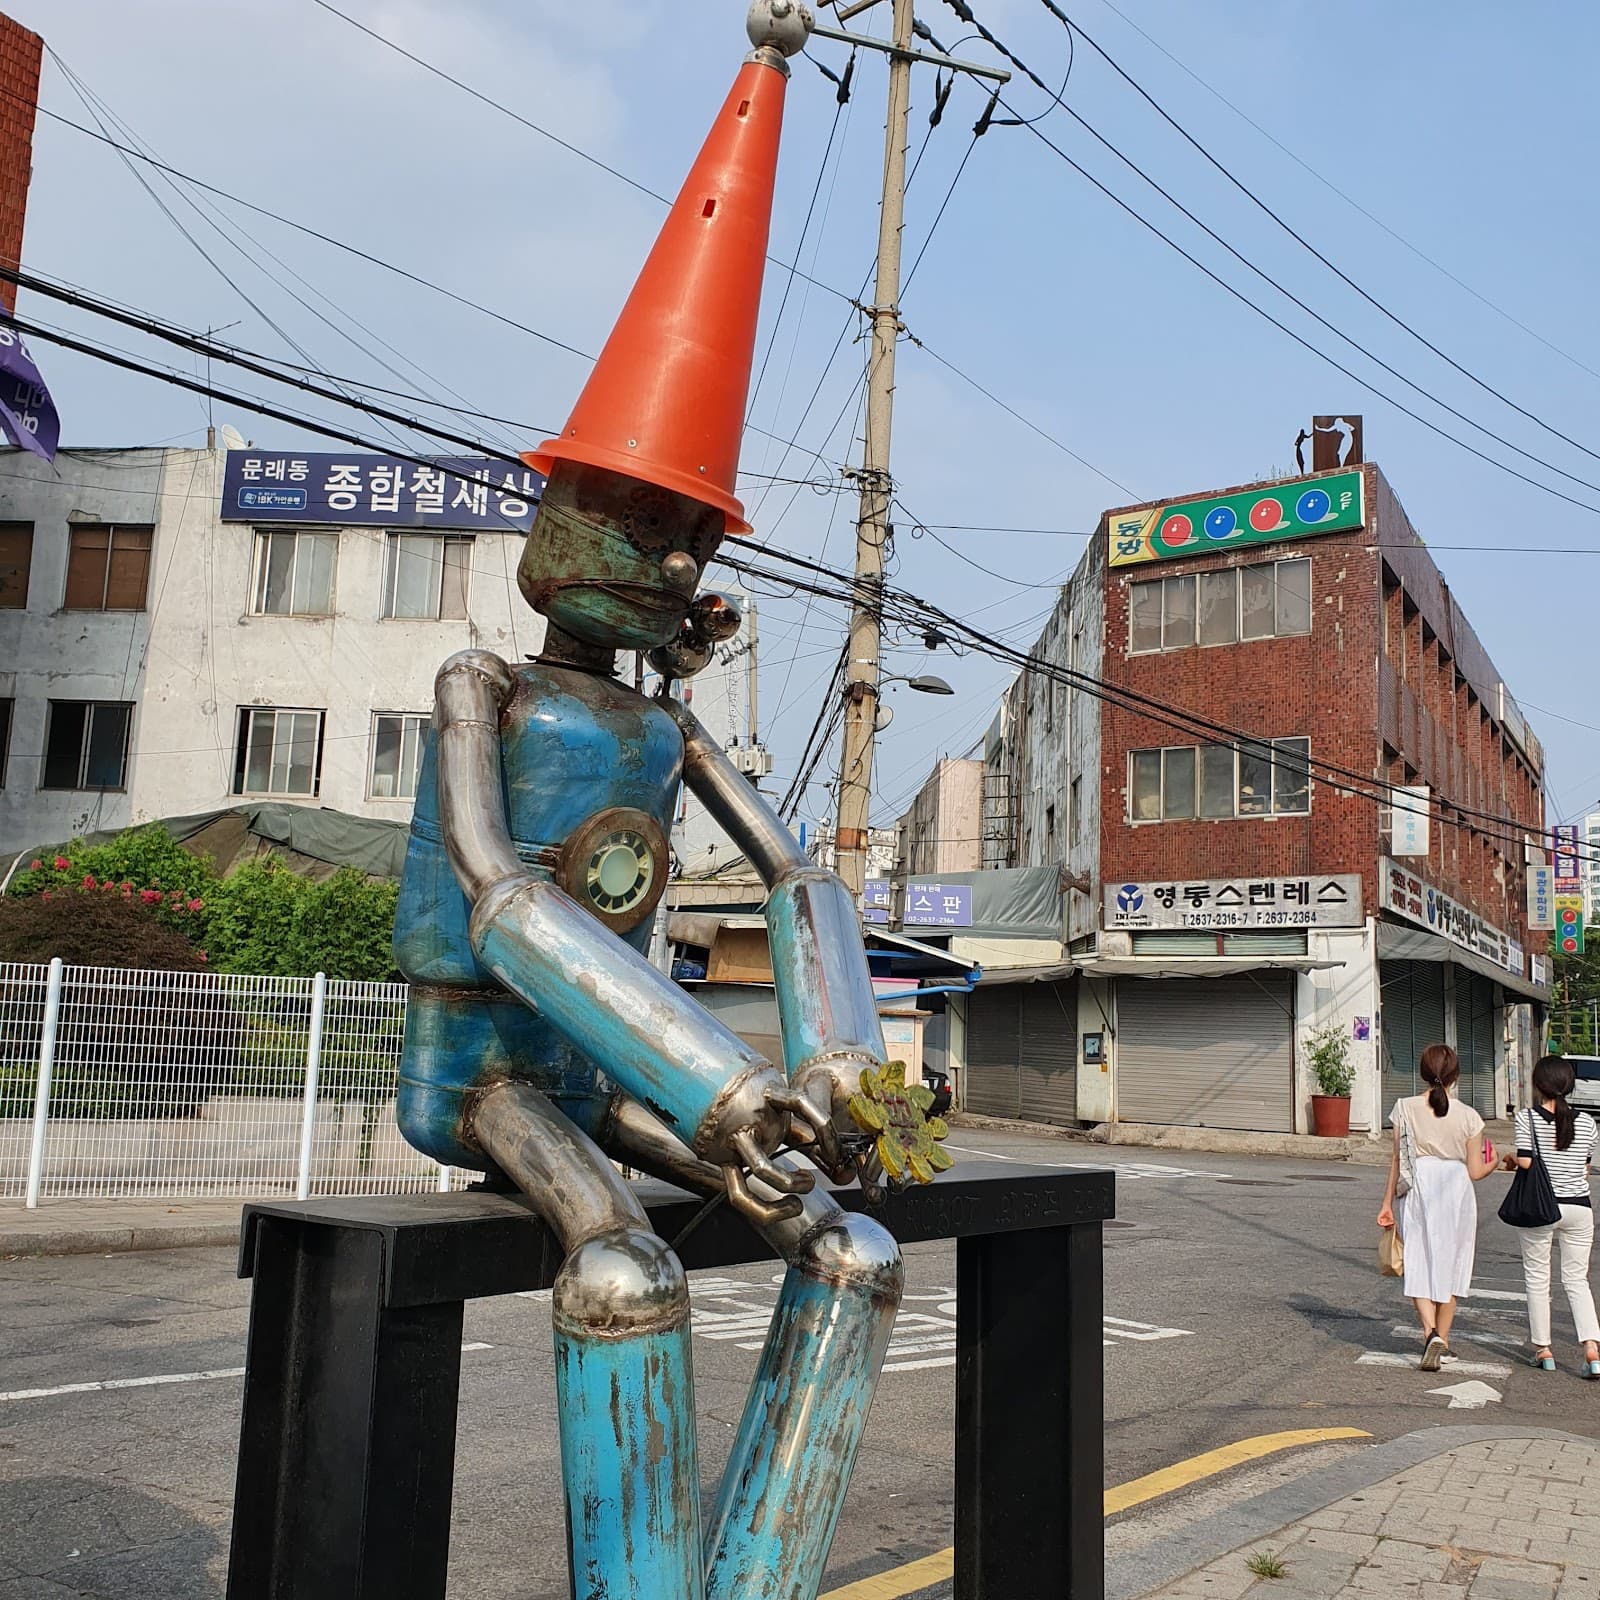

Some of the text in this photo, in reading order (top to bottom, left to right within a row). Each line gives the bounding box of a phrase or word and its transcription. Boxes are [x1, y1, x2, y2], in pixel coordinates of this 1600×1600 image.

[241, 459, 310, 481] 문래동
[324, 464, 547, 517] 종합철재상
[1340, 491, 1353, 510] 2F
[1117, 519, 1145, 556] 동방
[942, 896, 962, 914] 판
[1153, 880, 1348, 909] 영동스텐레스
[1256, 911, 1317, 924] F.2637-2364
